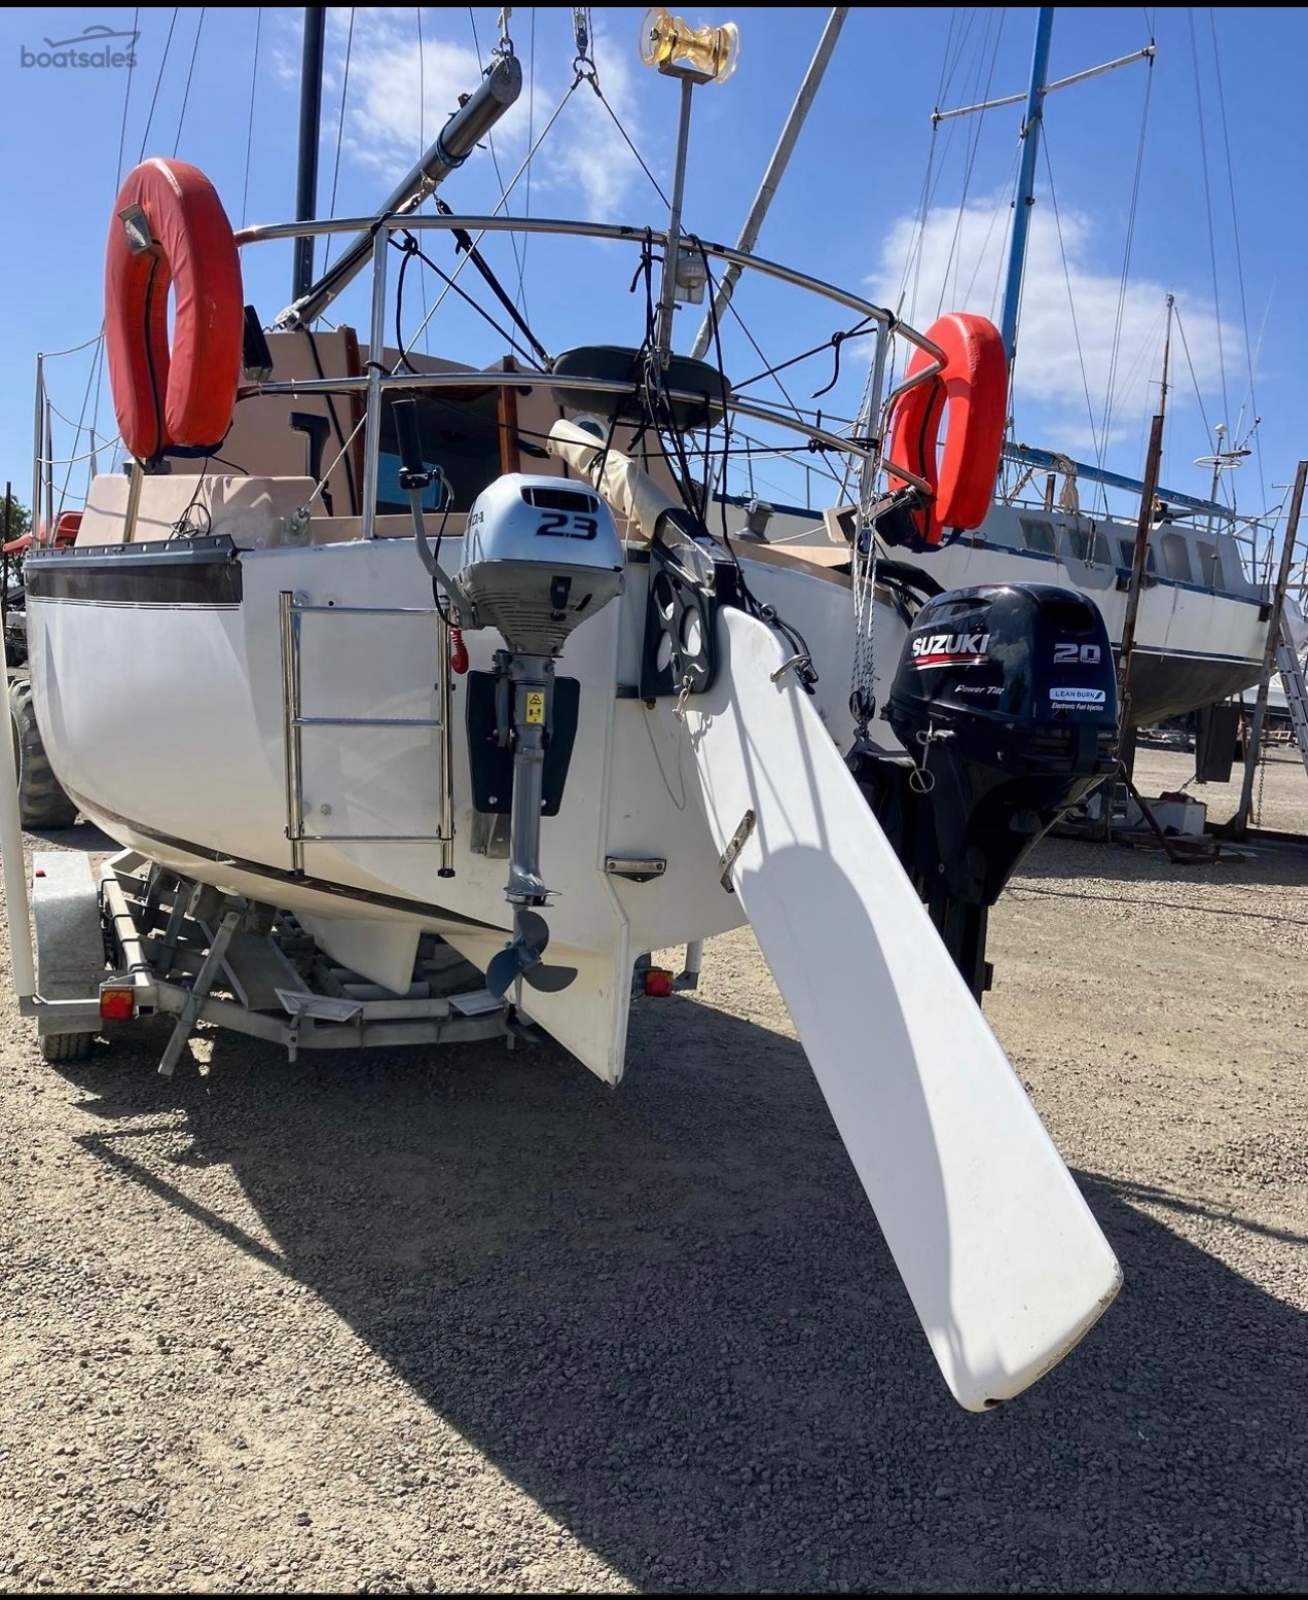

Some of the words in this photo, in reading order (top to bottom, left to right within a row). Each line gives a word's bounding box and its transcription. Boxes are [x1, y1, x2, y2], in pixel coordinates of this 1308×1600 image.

[912, 634, 990, 657] SUZUKI
[1053, 643, 1101, 664] 20
[954, 684, 985, 693] Power
[1055, 690, 1075, 698] LEAN
[1051, 702, 1075, 710] Electronic
[1086, 704, 1104, 712] Injection
